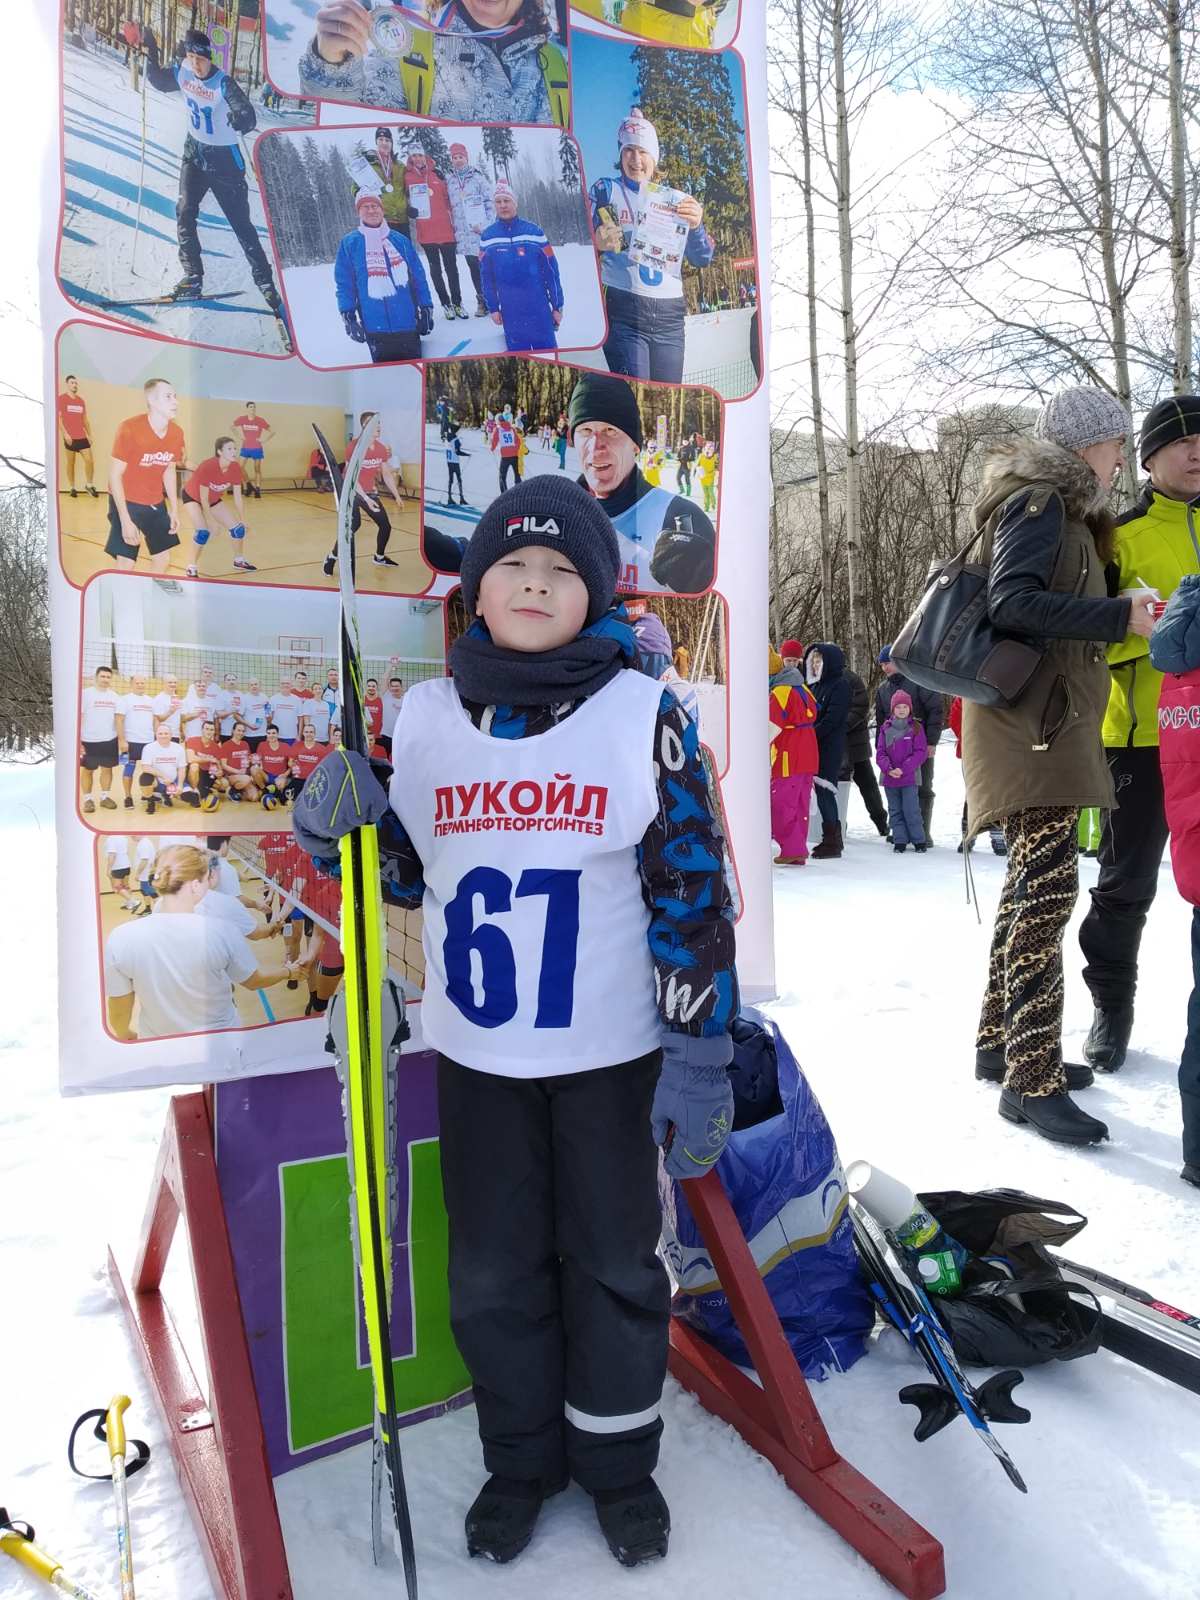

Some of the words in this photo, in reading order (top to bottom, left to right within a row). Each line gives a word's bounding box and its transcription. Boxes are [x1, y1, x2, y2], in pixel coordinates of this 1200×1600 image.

[186, 97, 214, 135] 31
[506, 516, 561, 537] FILA
[434, 772, 609, 822] ЛУКОЙЛ
[434, 816, 604, 838] ПЕРМНЕФТЕОРГСИНТЕЗ
[442, 865, 583, 1029] 67
